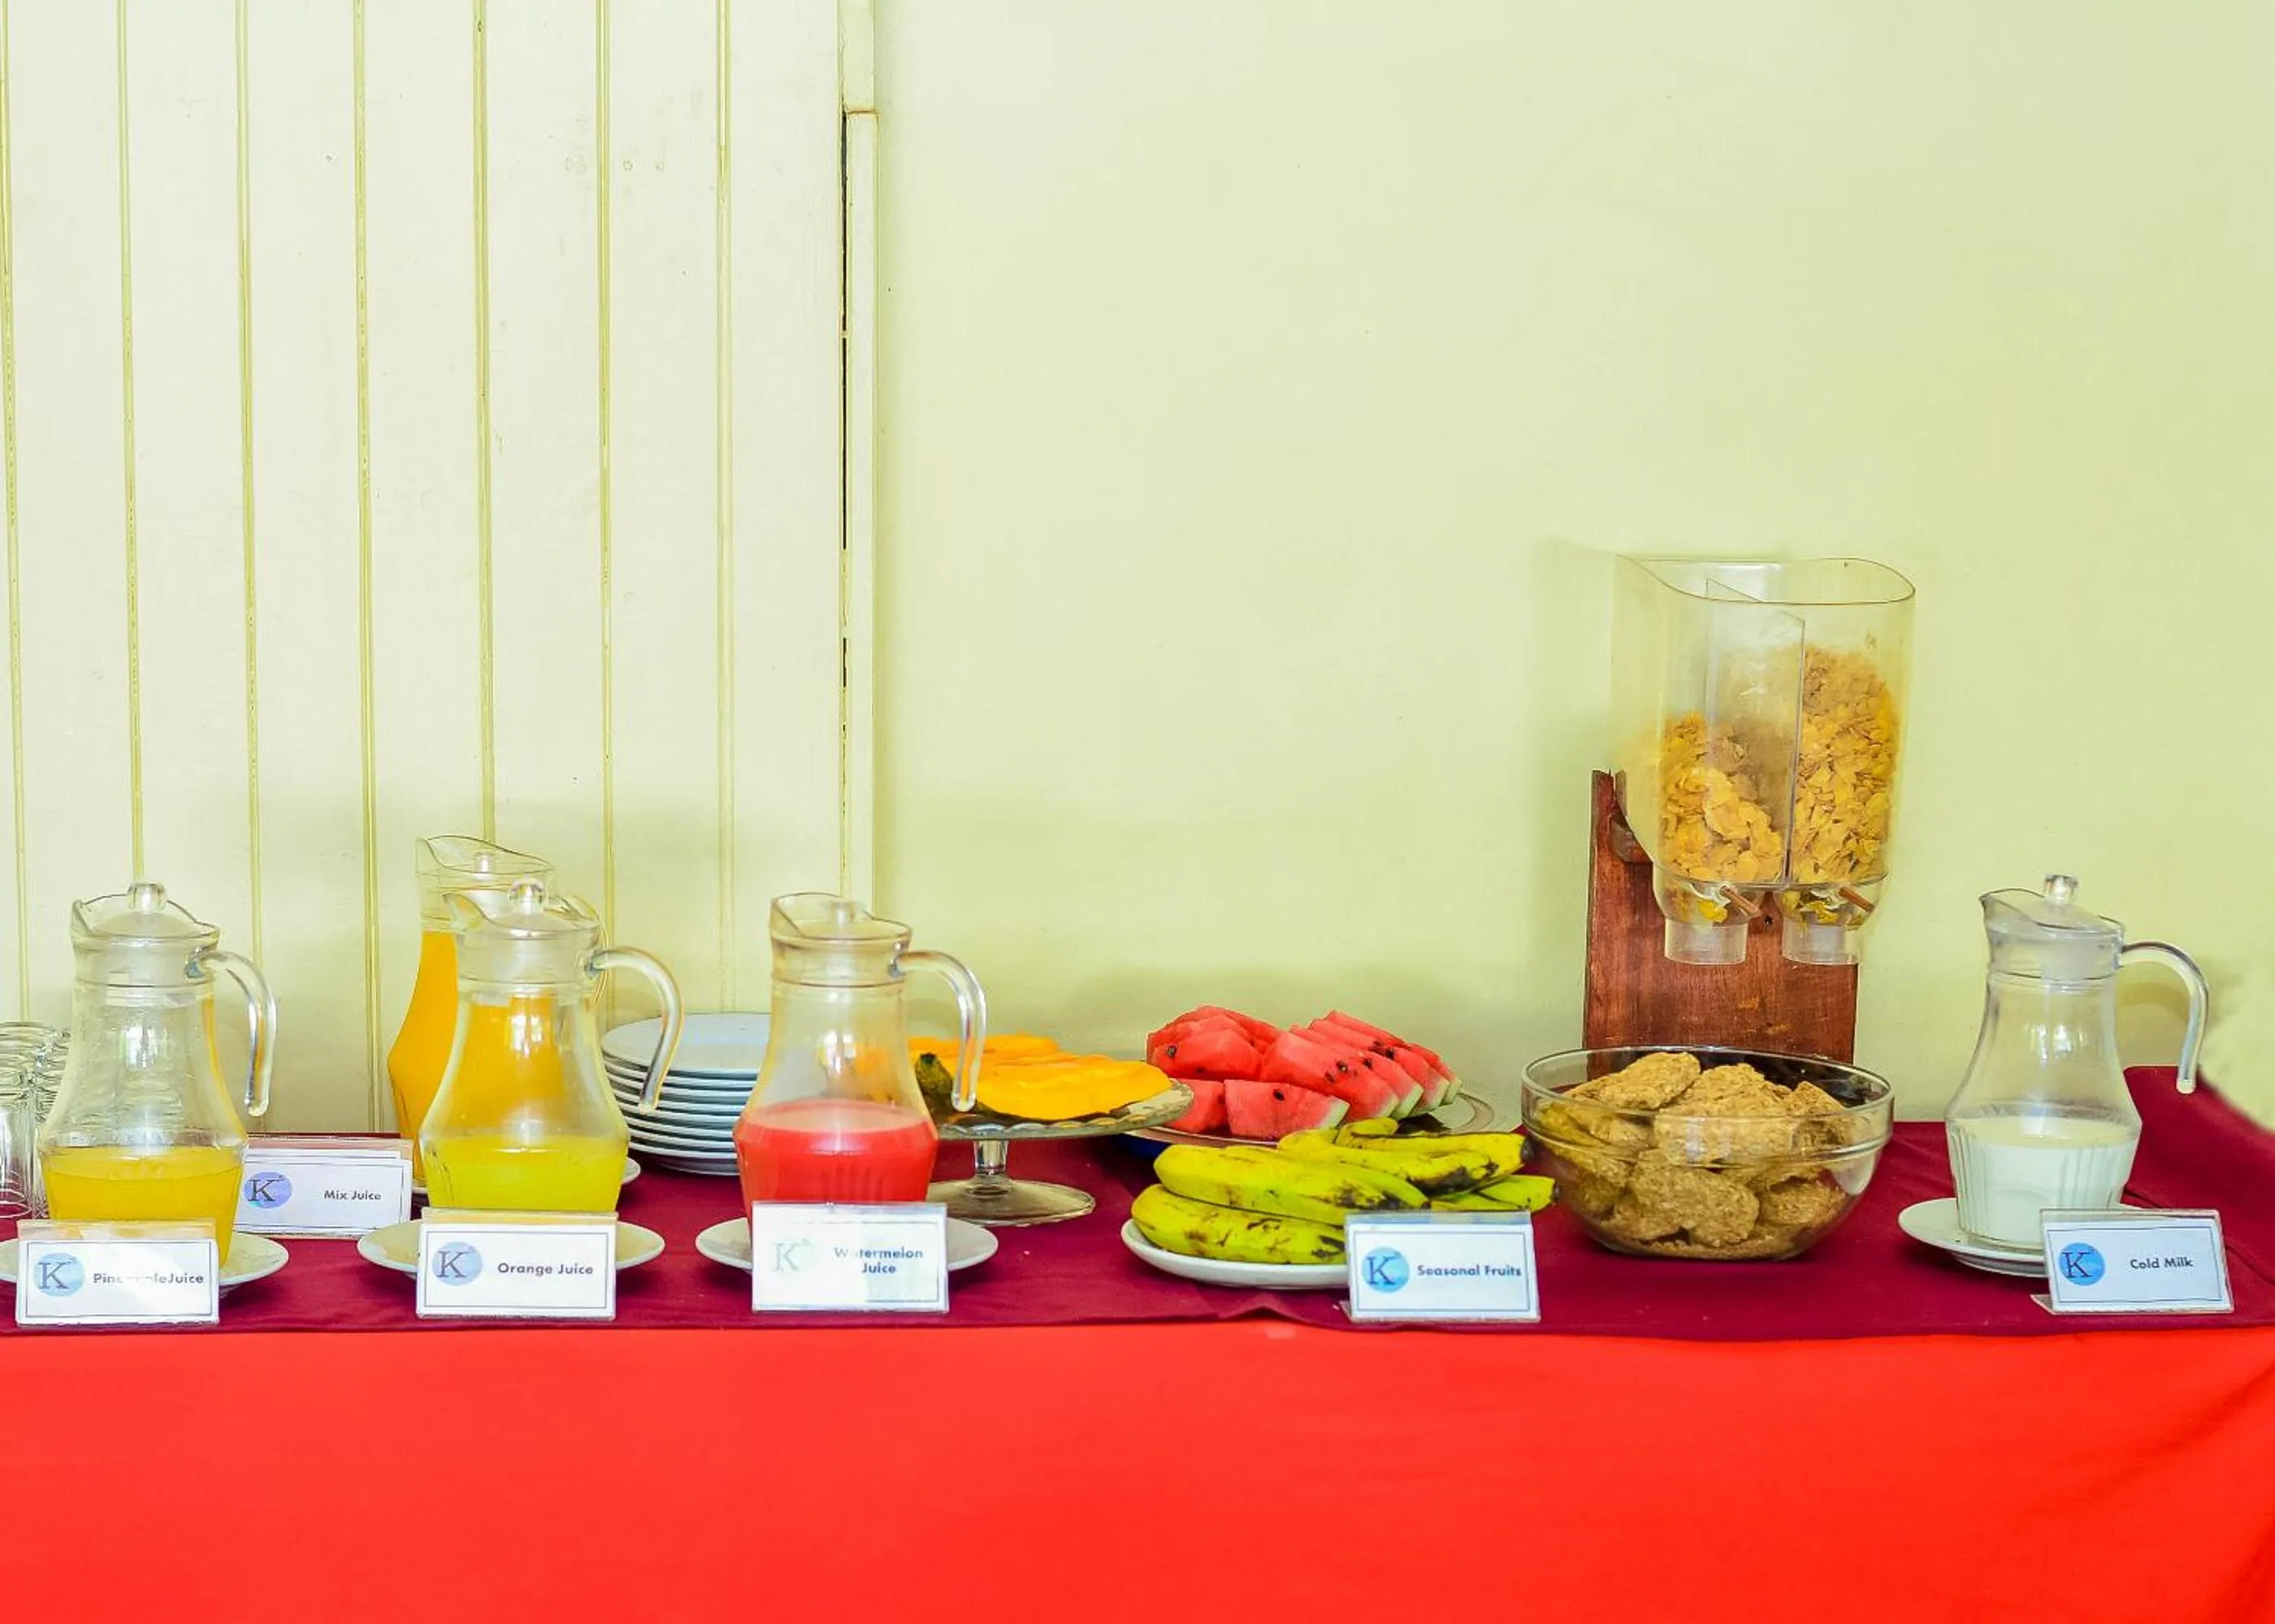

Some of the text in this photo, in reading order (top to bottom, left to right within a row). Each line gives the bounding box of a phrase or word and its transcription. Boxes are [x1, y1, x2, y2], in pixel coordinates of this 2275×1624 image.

[247, 1177, 279, 1202] K
[323, 1189, 381, 1200] Mix Juice
[834, 1246, 924, 1258] Wtermelon
[436, 1249, 469, 1279] K
[497, 1262, 593, 1275] Orange Juice
[861, 1262, 897, 1274] Juice
[1366, 1255, 1397, 1285] K
[1417, 1264, 1522, 1276] Seasonal Fruits
[2062, 1251, 2093, 1279] K
[2130, 1256, 2194, 1270] Cold Milk
[37, 1260, 72, 1290] K
